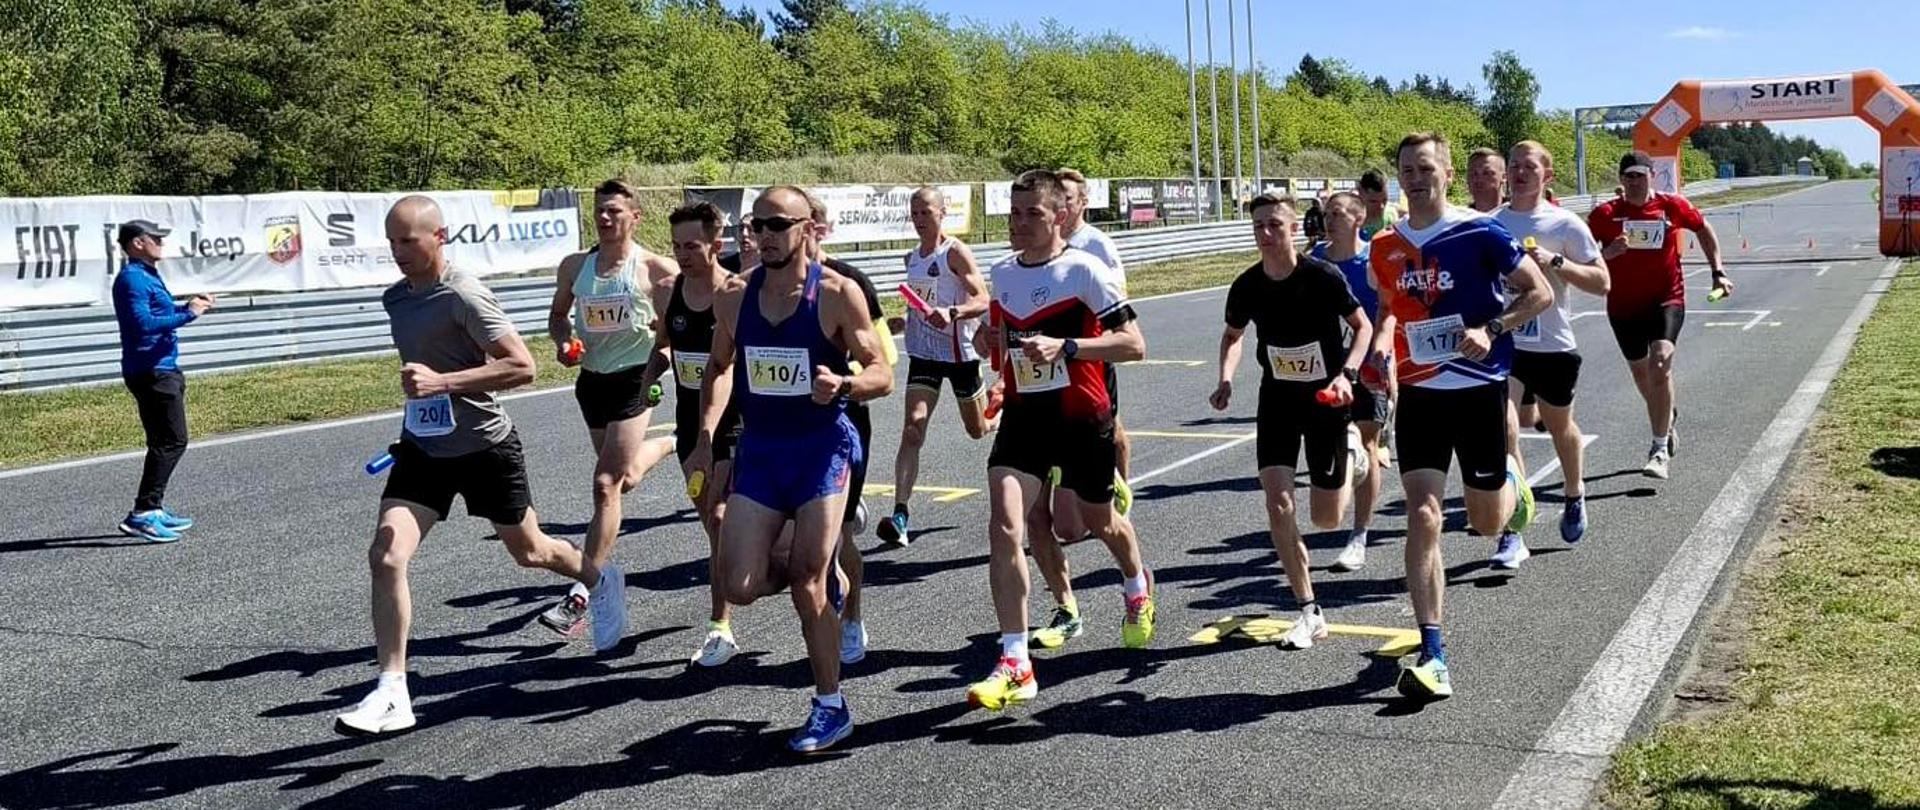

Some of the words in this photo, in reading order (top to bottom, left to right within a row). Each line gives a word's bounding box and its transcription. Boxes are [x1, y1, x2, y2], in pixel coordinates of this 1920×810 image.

[1751, 79, 1840, 99] START
[865, 192, 910, 208] DETAILIN
[838, 210, 880, 225] SERWIS
[508, 218, 568, 242] IVECO
[15, 224, 80, 279] FIAT
[180, 230, 245, 261] Jeep
[317, 253, 365, 267] SEAT
[768, 363, 807, 386] 10/5
[1288, 356, 1321, 374] 12/1
